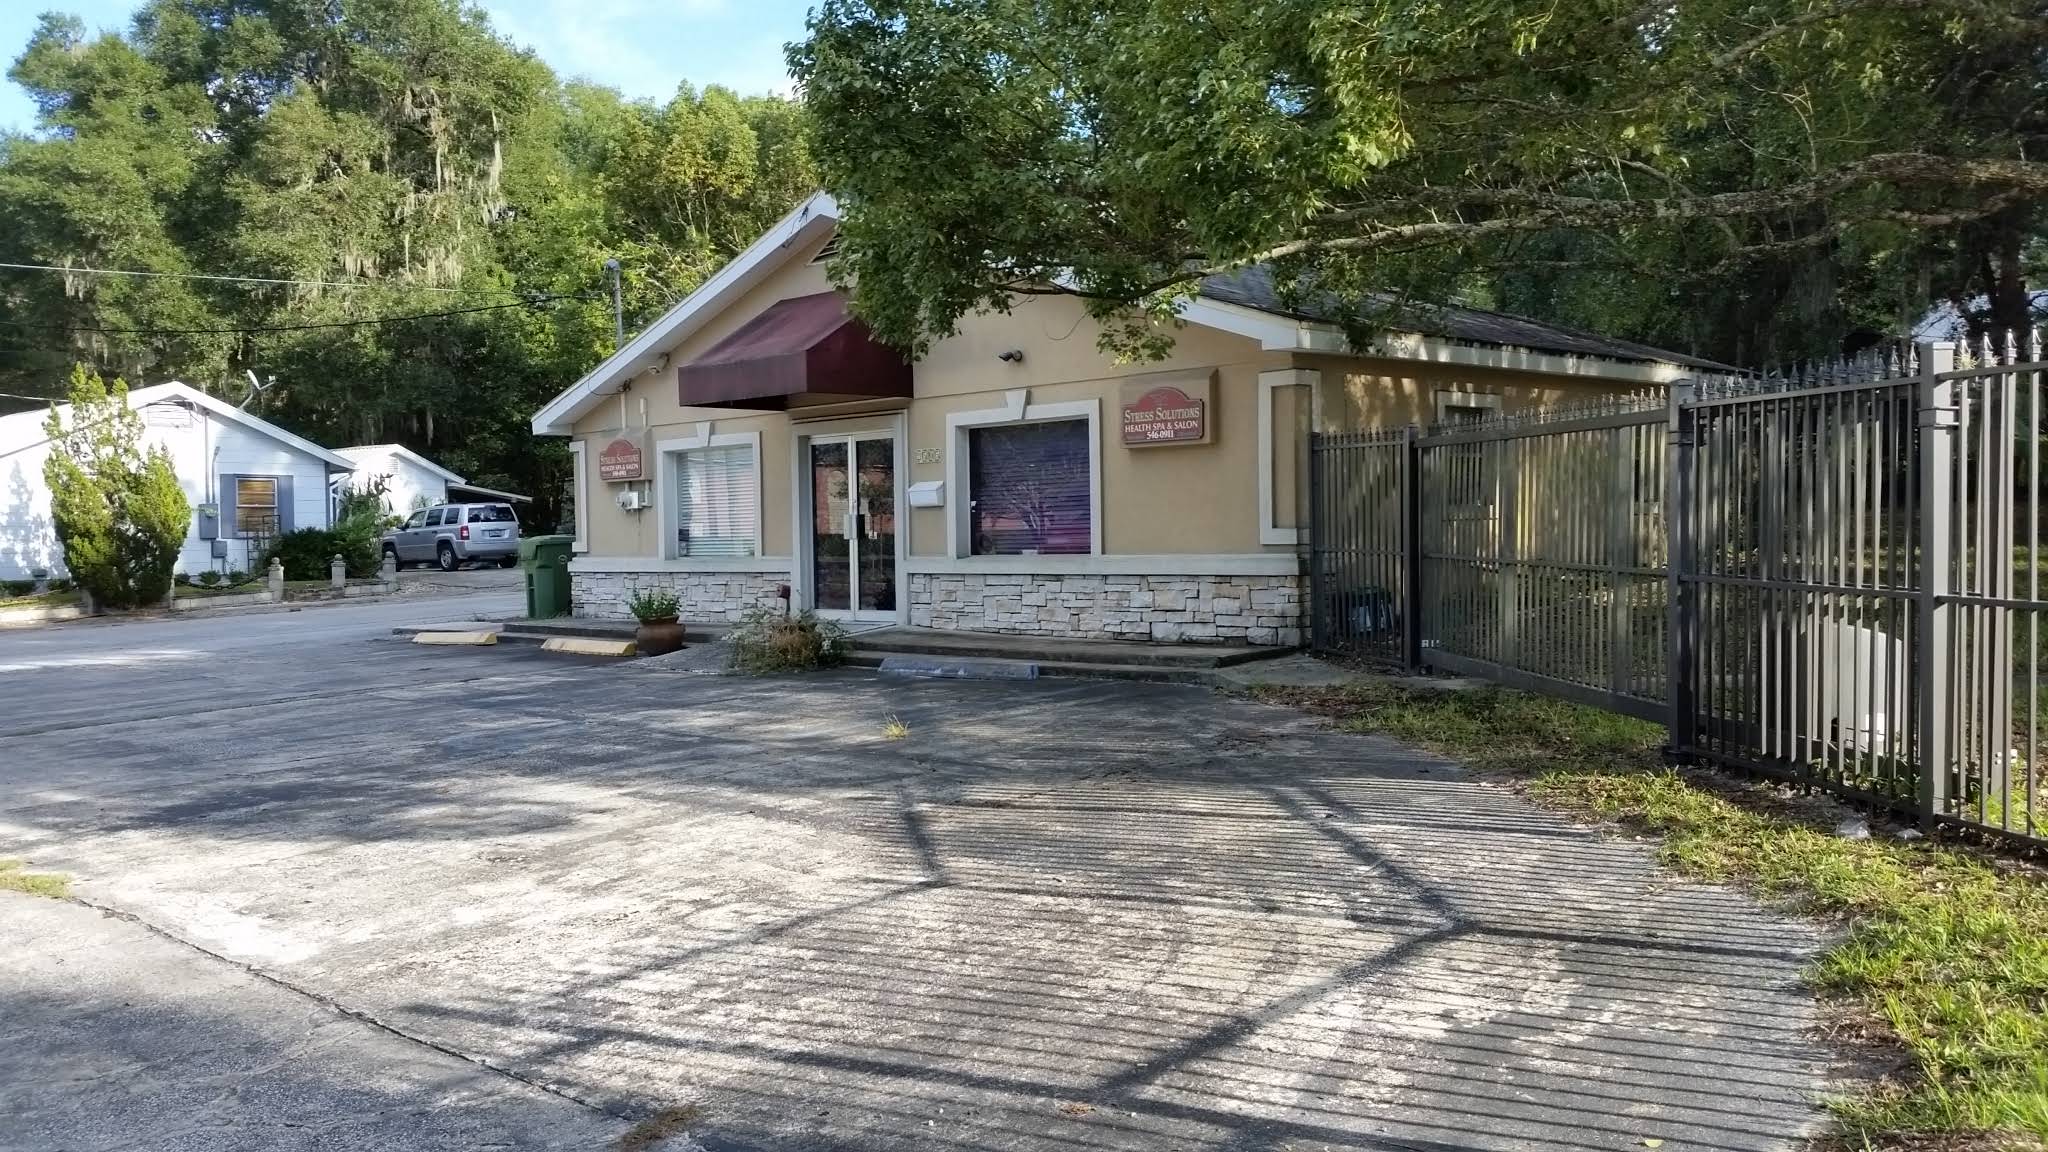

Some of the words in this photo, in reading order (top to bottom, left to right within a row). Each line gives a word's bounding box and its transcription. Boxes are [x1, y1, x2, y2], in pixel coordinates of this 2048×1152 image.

[1156, 408, 1199, 420] SOLUTIONS
[1125, 424, 1151, 432] HEALTH
[1152, 422, 1165, 431] SPA
[1166, 421, 1172, 430] &
[1174, 420, 1198, 429] SALON
[1146, 430, 1174, 440] 546-0911
